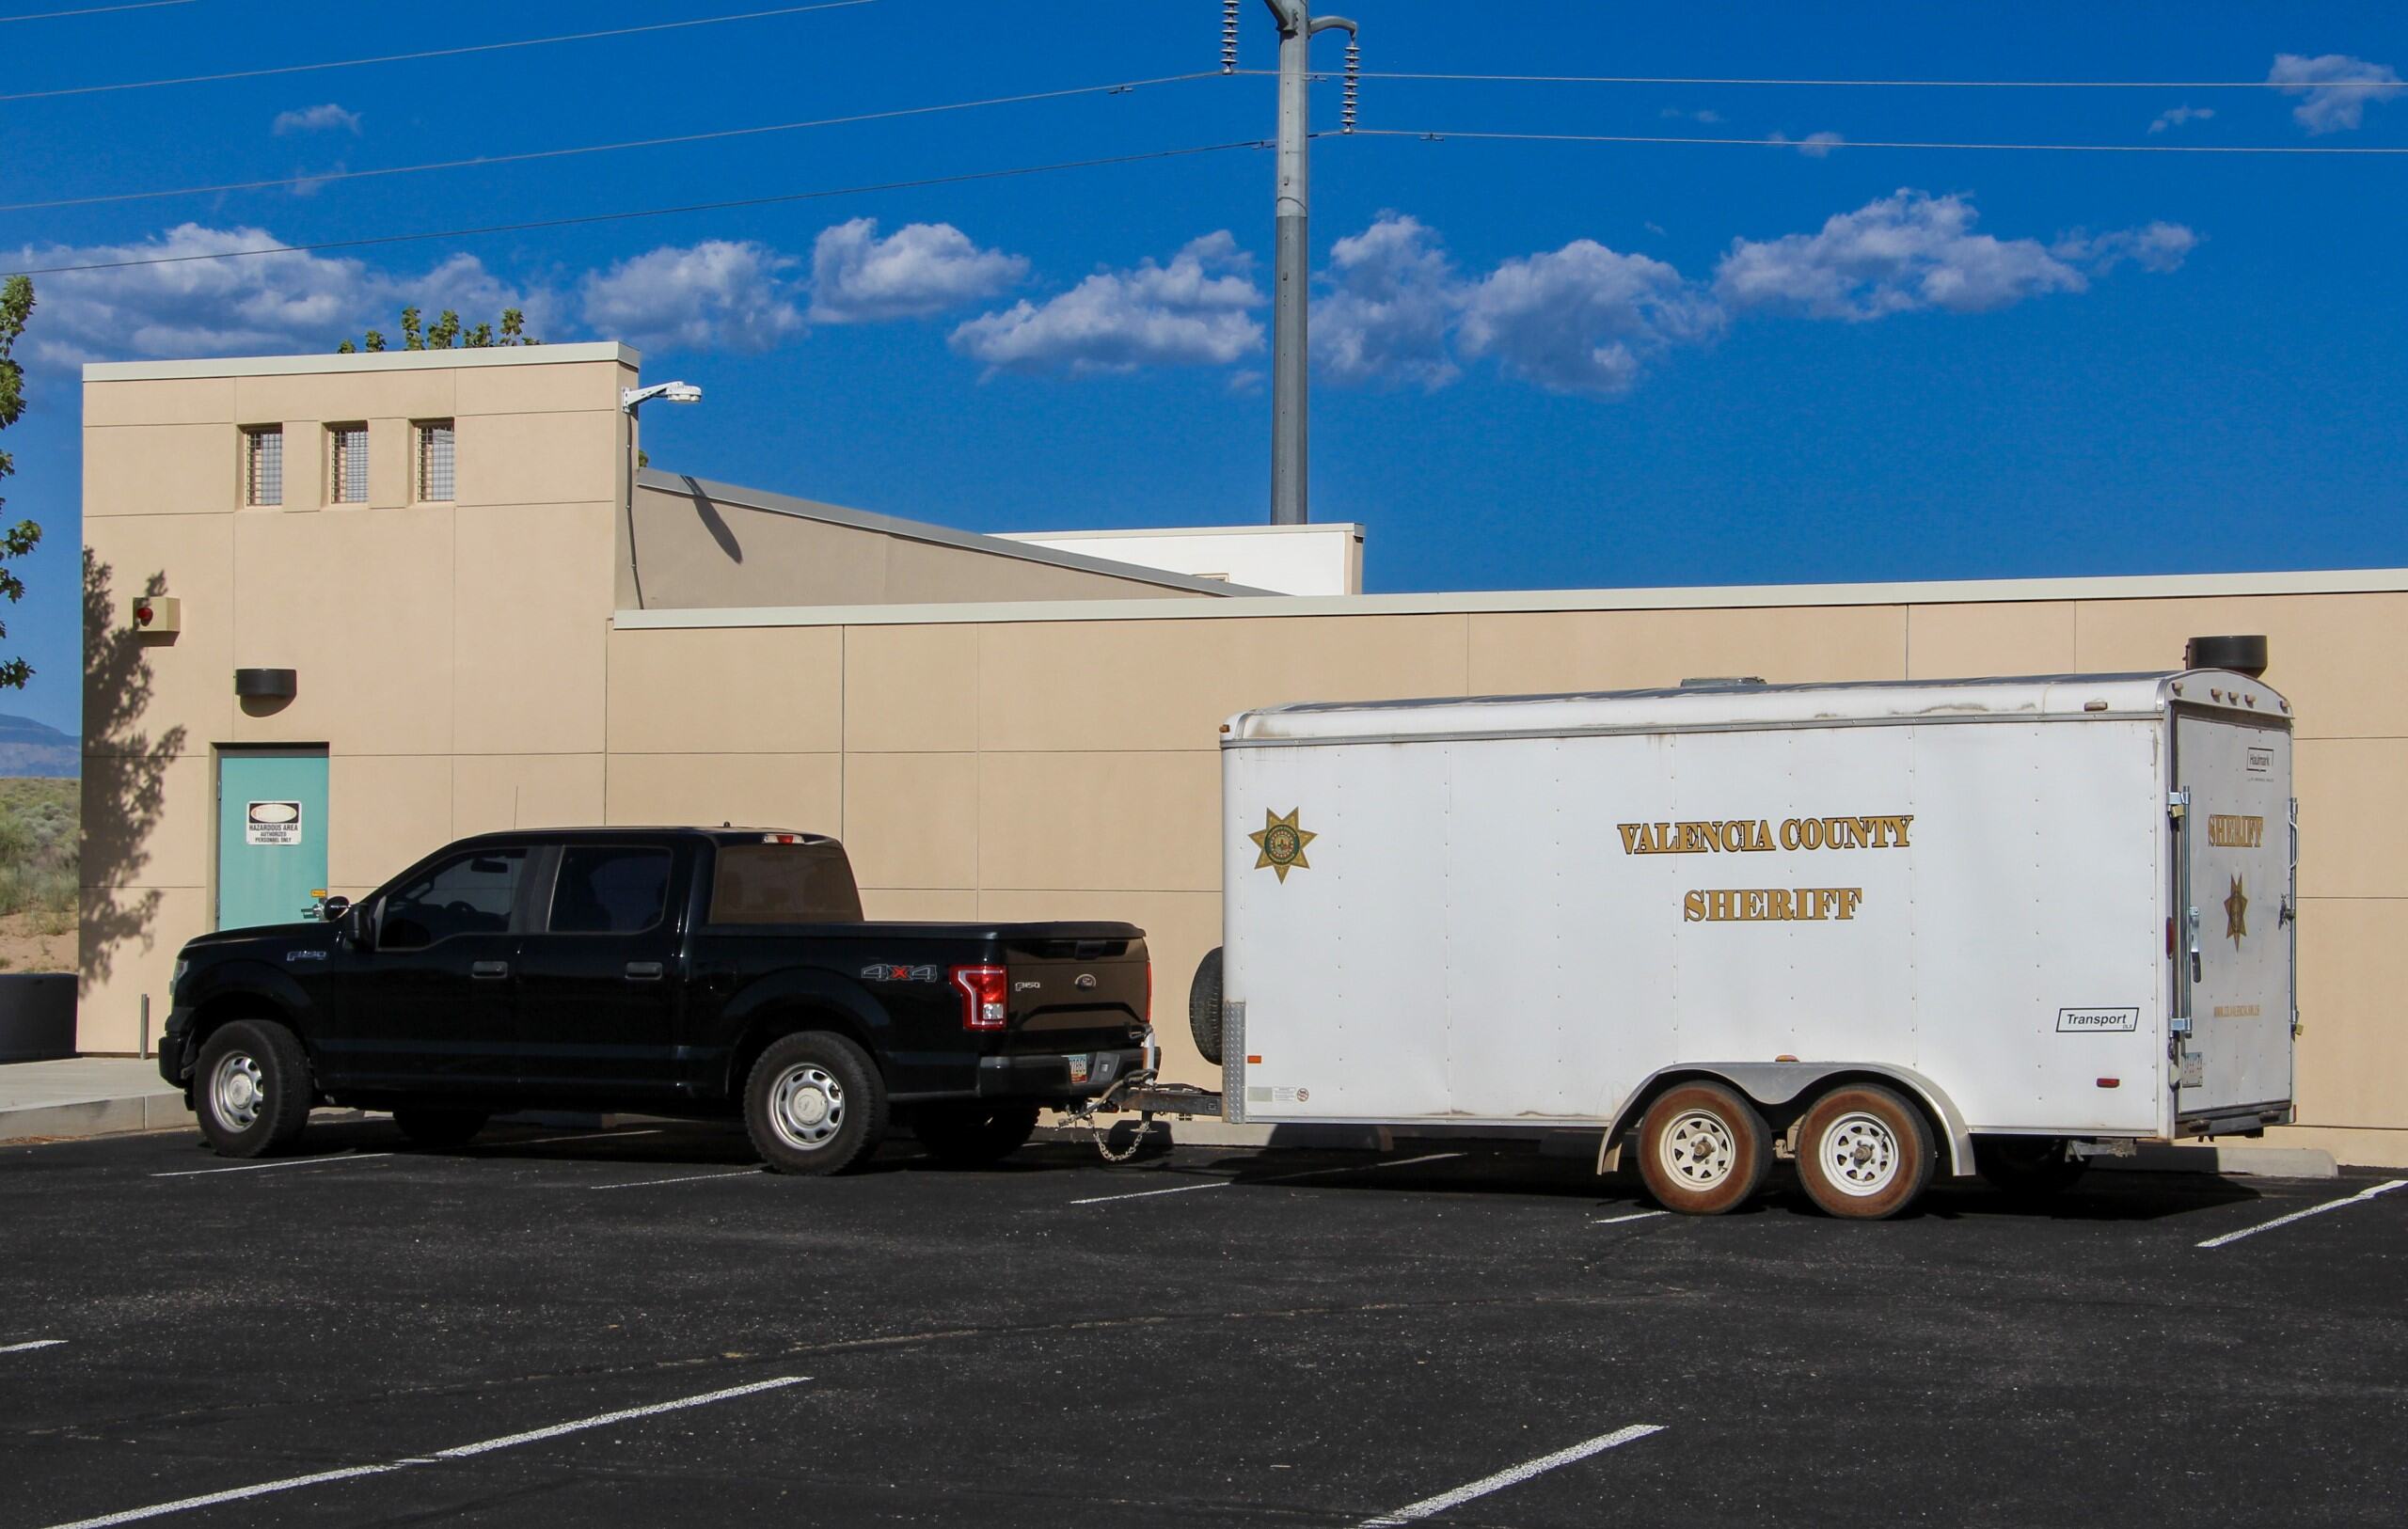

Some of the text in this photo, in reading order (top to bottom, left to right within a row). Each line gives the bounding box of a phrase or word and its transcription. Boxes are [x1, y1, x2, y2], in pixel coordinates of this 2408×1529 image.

[1617, 815, 1913, 855] VALENCIA COUNTY
[2209, 814, 2263, 847] SHERIFF
[1684, 888, 1862, 922] SHERIFF
[2067, 1014, 2127, 1027] Transport
